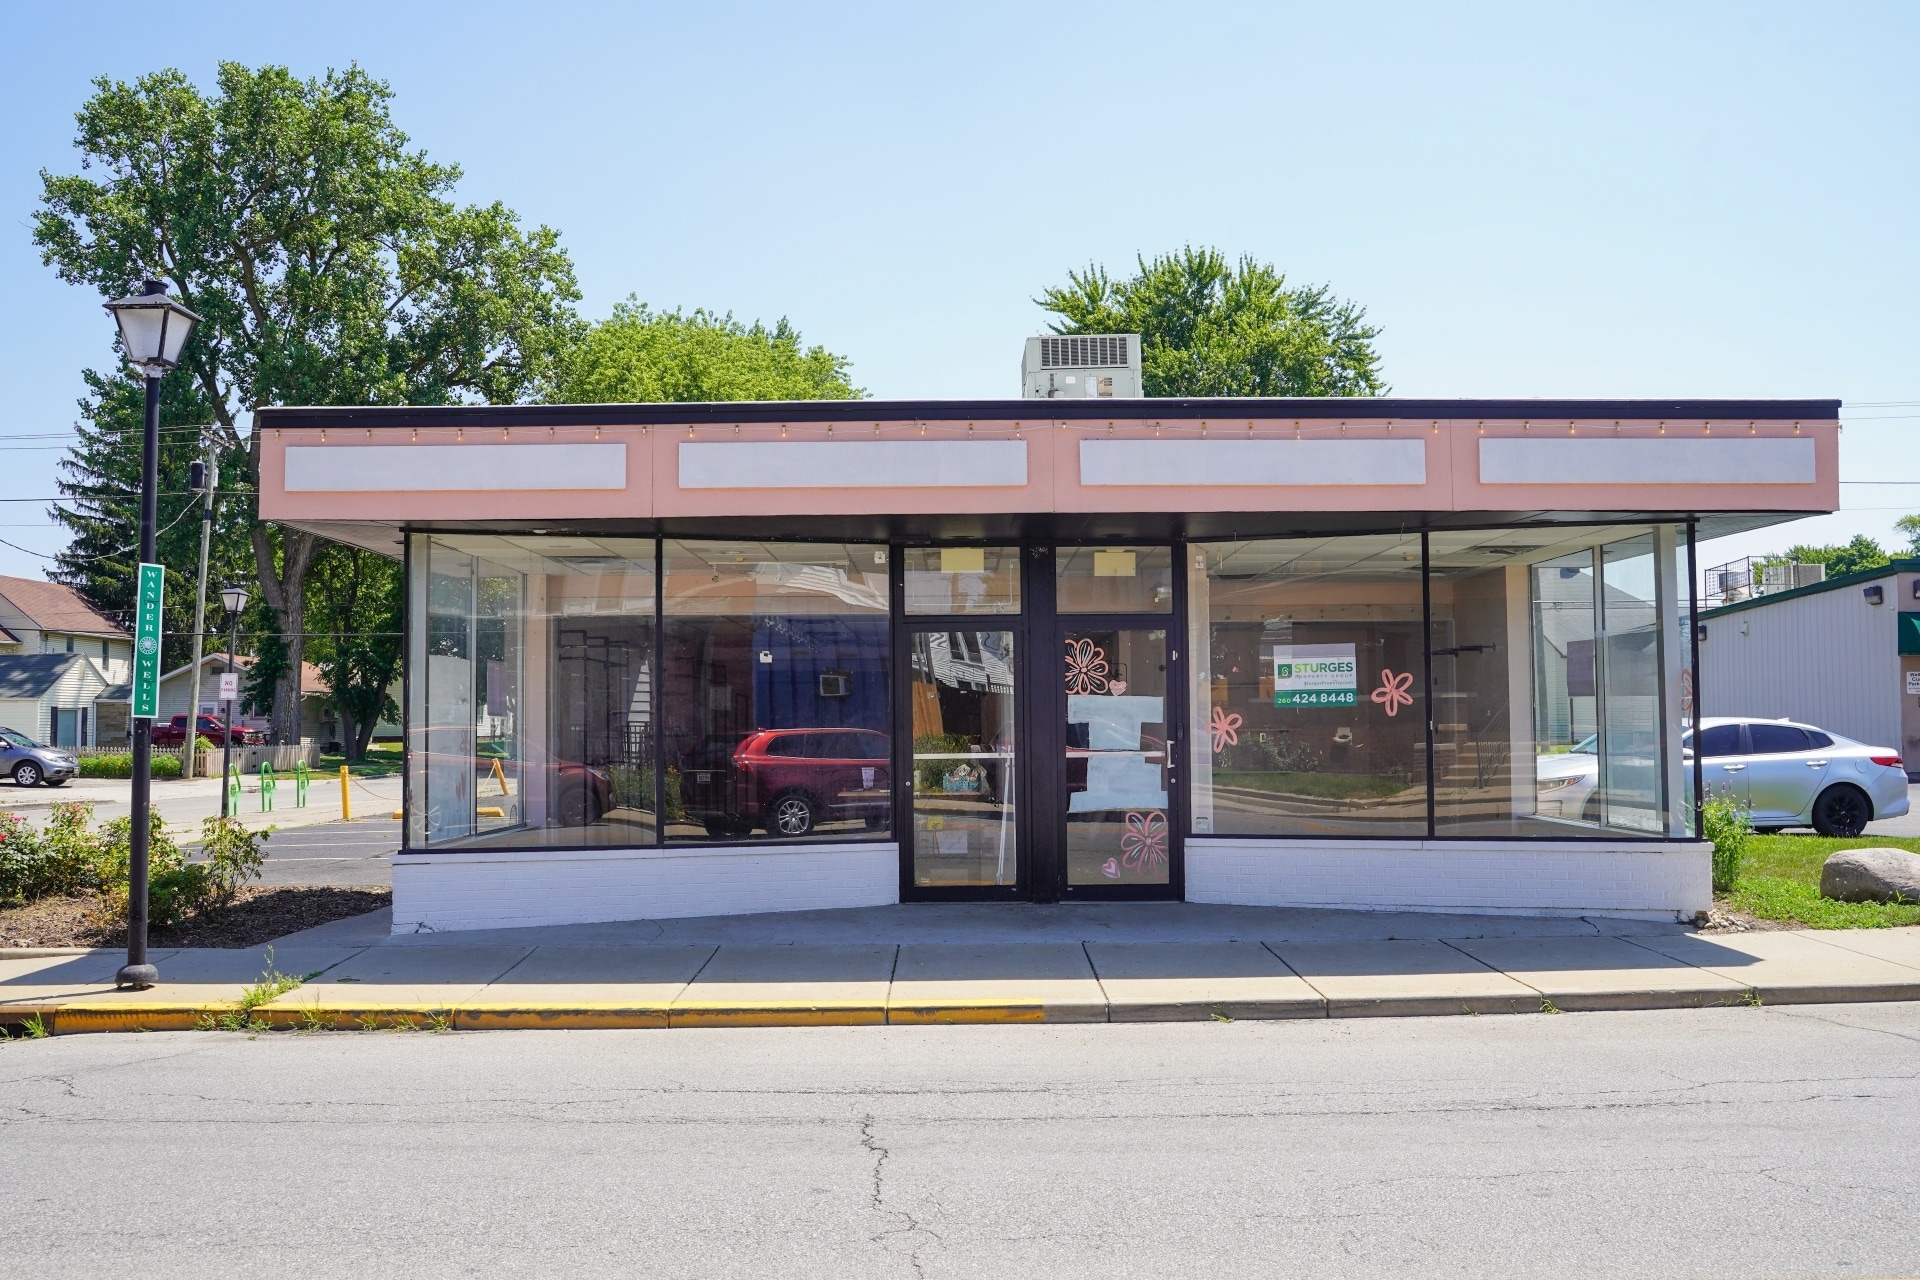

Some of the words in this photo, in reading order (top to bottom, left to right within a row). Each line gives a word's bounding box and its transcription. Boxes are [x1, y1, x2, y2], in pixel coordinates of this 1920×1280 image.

[145, 570, 157, 632] WANDER
[1294, 662, 1354, 674] STURGES
[141, 660, 153, 712] WELLS
[1292, 693, 1317, 704] 424
[1320, 692, 1354, 703] 8448
